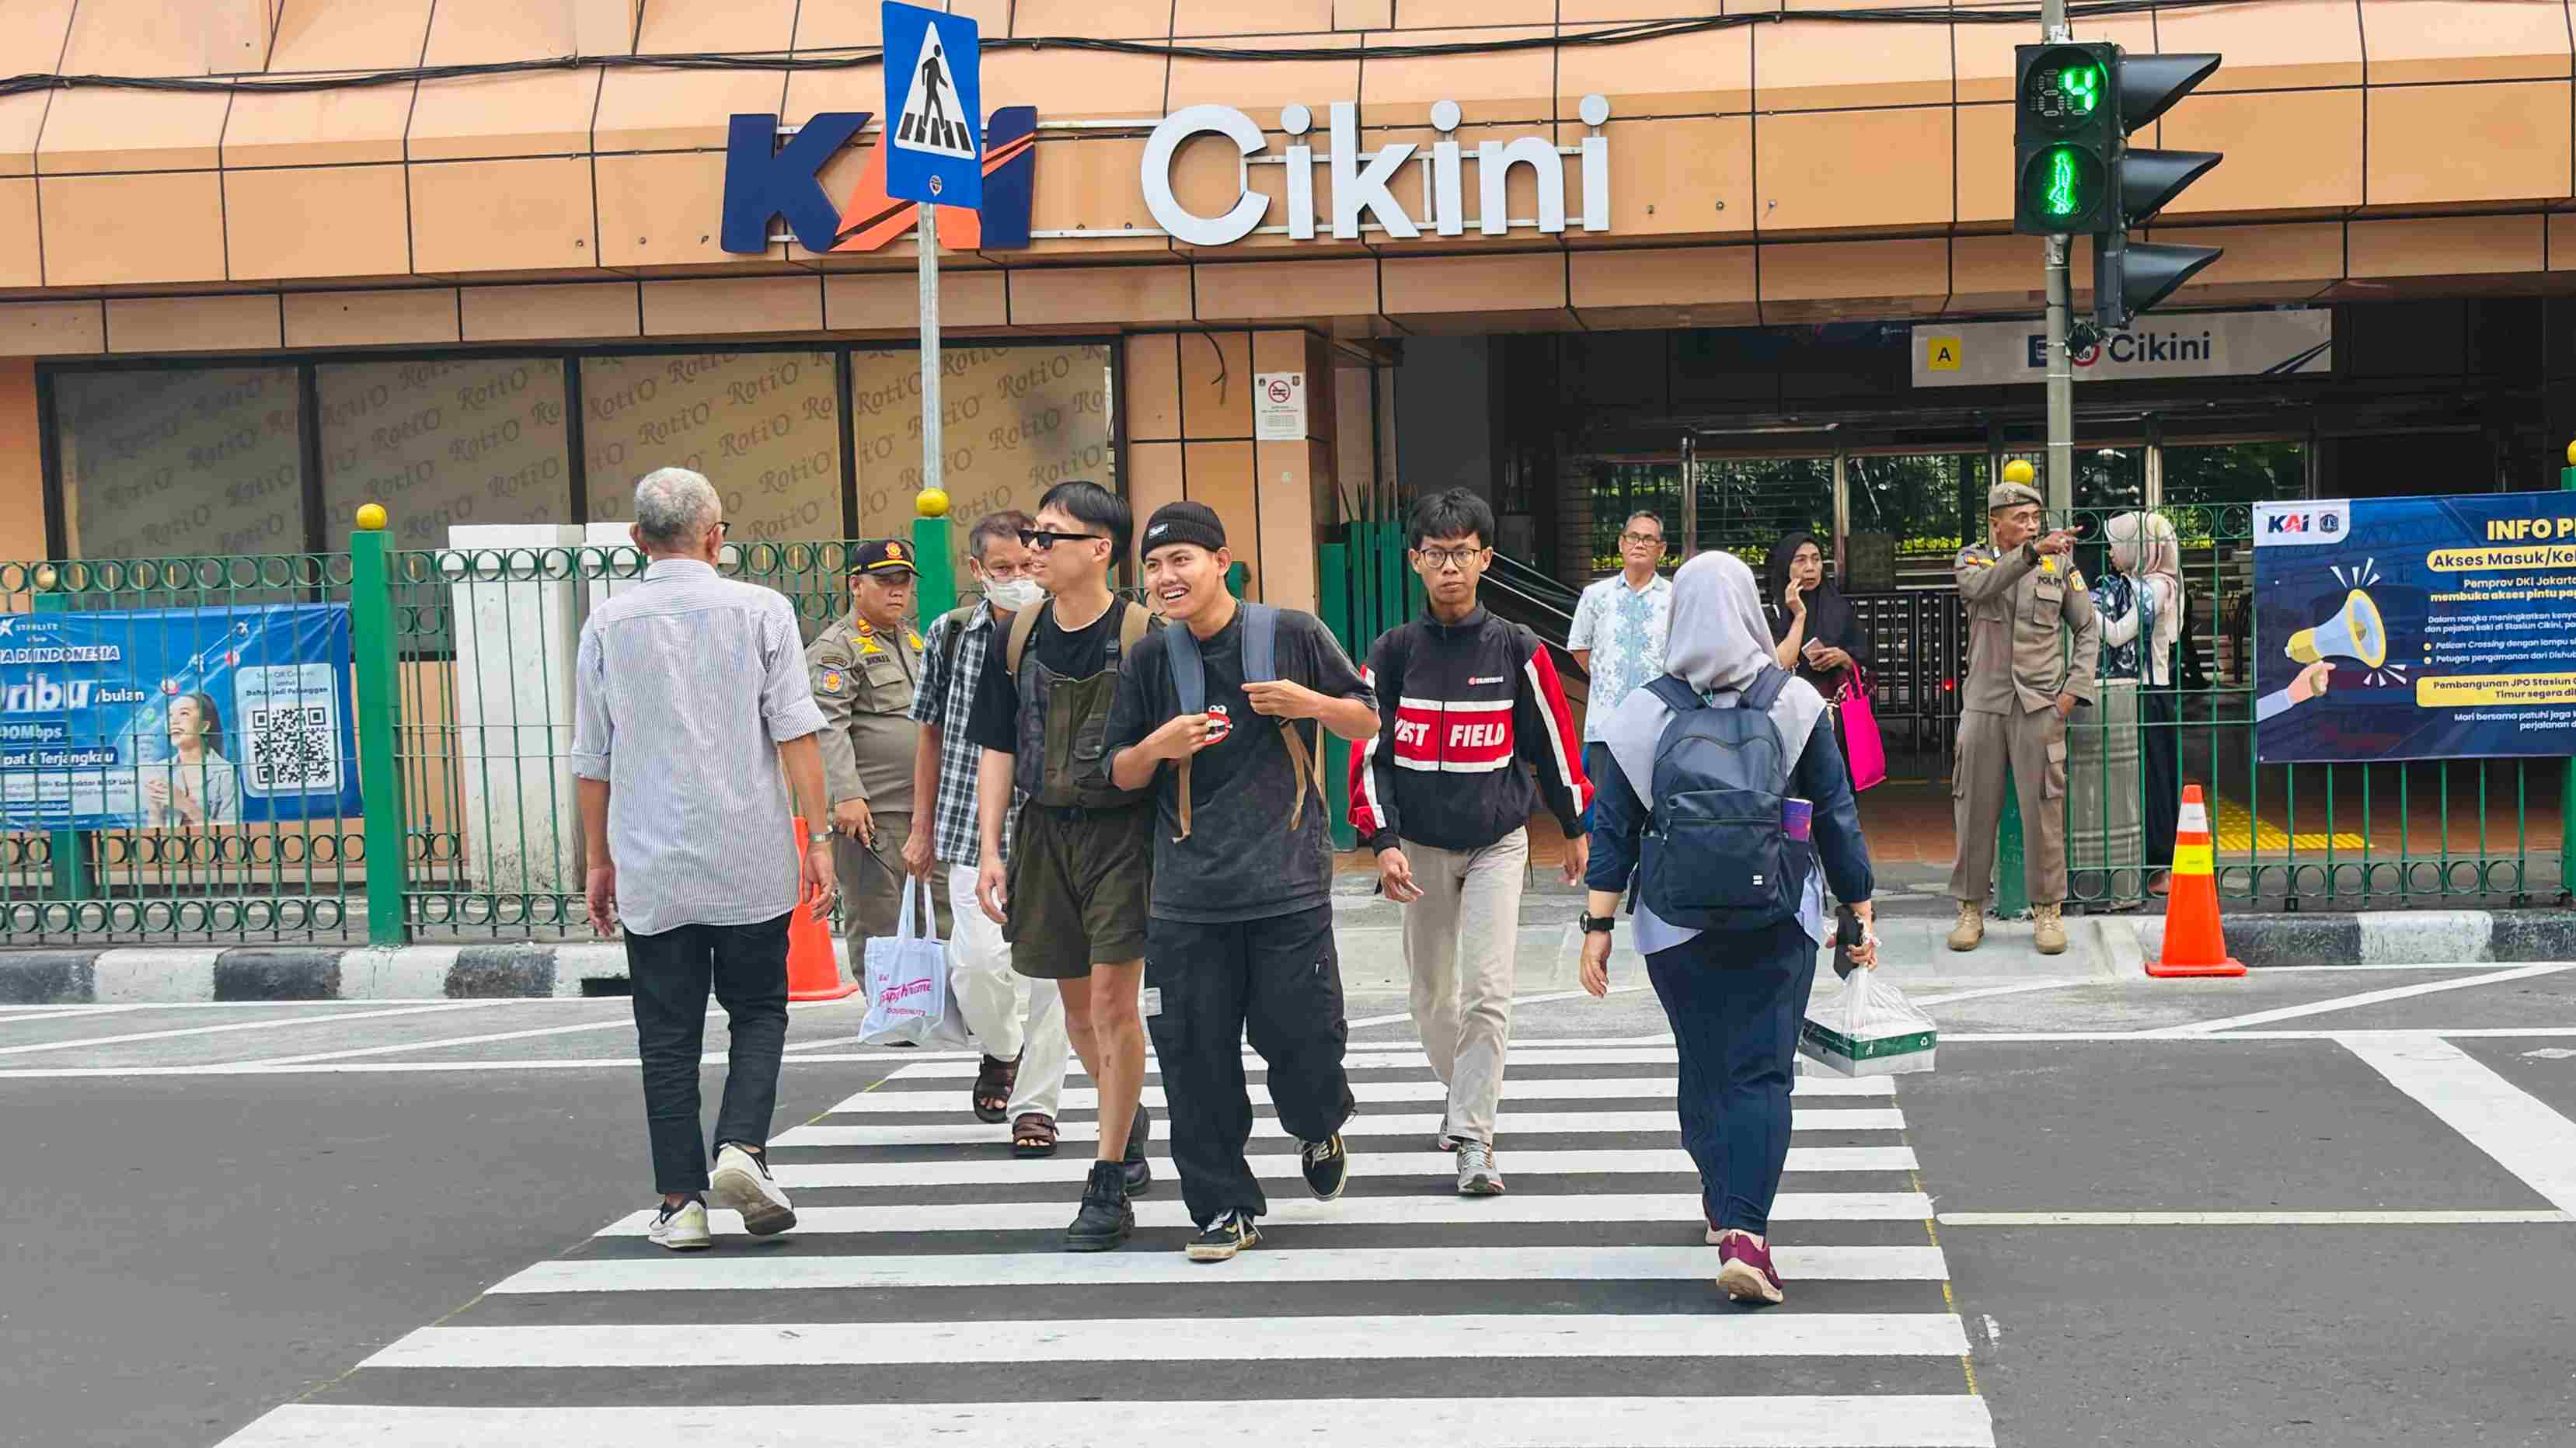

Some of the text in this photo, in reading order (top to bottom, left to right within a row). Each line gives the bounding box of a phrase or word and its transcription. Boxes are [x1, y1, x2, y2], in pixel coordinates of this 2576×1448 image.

[2065, 66, 2097, 110] 4
[1141, 94, 1611, 245] Cikini
[2109, 331, 2211, 362] Cikini
[1937, 347, 1951, 361] A
[2487, 519, 2552, 541] INFO
[2433, 554, 2484, 567] Akses
[2463, 578, 2514, 590] Pemprov
[2516, 577, 2534, 587] DKI
[2430, 591, 2490, 602] membuka
[2491, 590, 2525, 600] akses
[2526, 588, 2557, 601] pintu
[2505, 621, 2536, 631] Stasiun
[2468, 639, 2505, 651] Crossing
[2506, 638, 2539, 649] dengan
[33, 646, 120, 661] INDONESIA
[2433, 679, 2509, 690] Pembangunan
[2511, 677, 2530, 687] JPO
[2532, 677, 2571, 686] Stasiun
[2496, 690, 2525, 698] Timur
[2527, 689, 2563, 700] segera
[2454, 712, 2474, 722] Mari
[2476, 712, 2518, 721] bersama
[2519, 719, 2570, 733] perjalanan
[1448, 722, 1506, 747] FIELD
